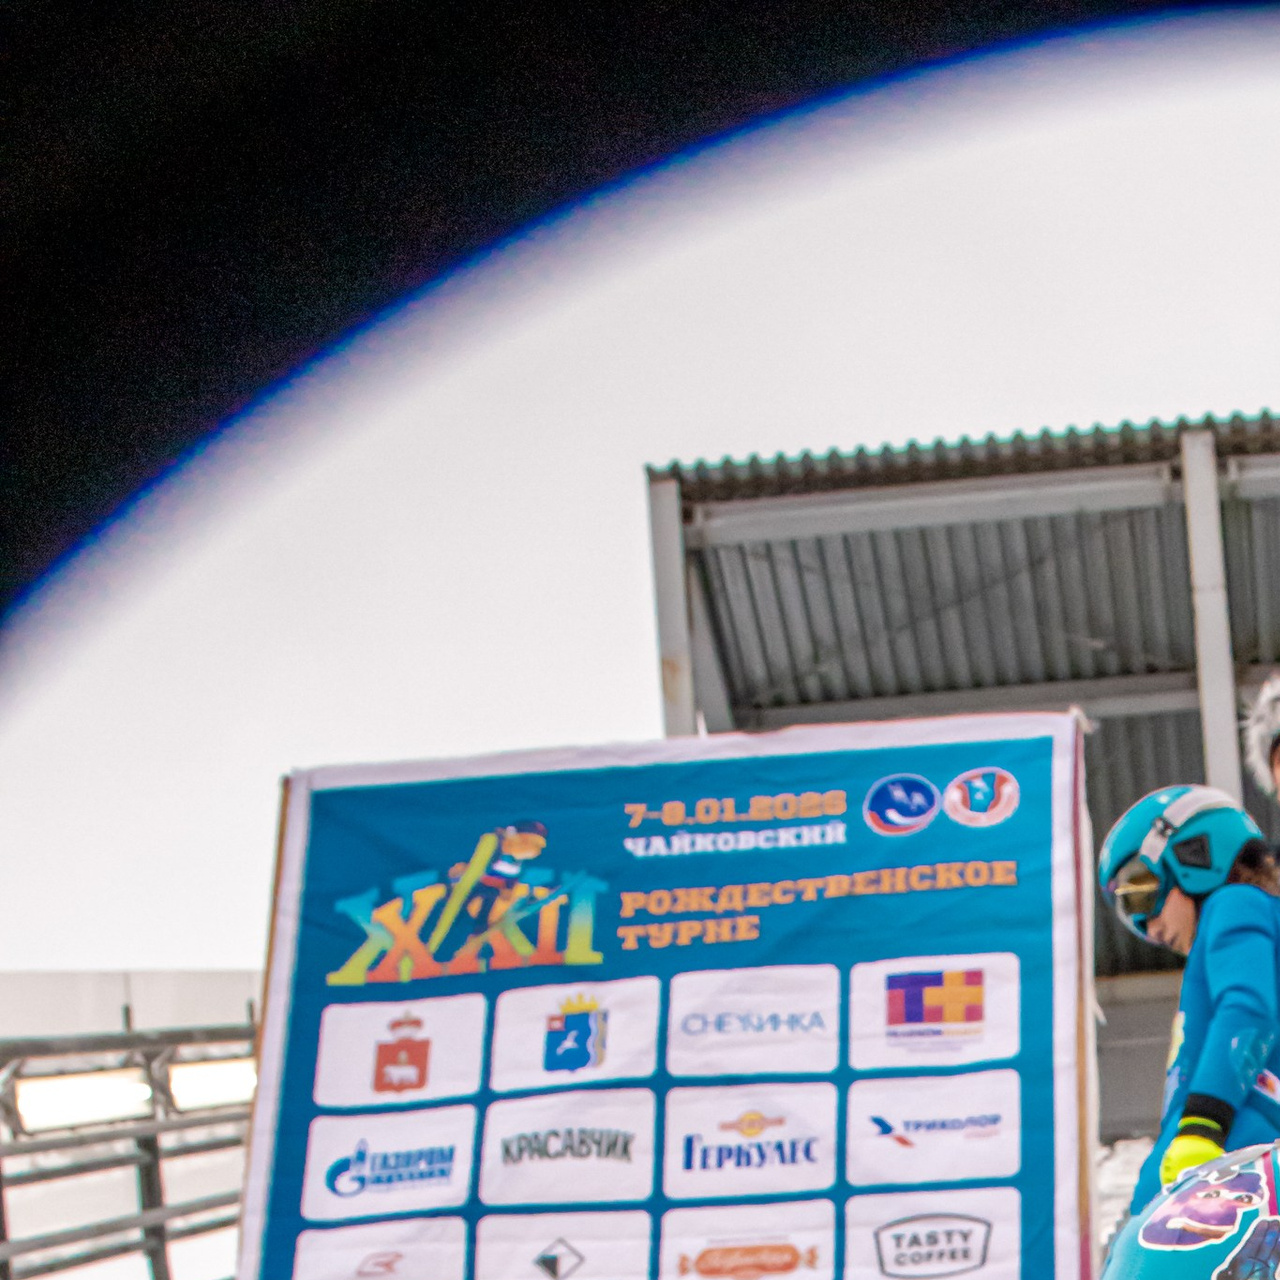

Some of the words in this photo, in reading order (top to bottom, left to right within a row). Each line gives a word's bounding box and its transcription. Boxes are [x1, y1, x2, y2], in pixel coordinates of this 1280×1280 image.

[623, 820, 848, 857] ЧАЙКОВСКИЙ
[619, 860, 1019, 918] РОЖДЕСТВЕНСКОЕ
[617, 915, 761, 950] ТУРНЕ
[501, 1127, 637, 1165] КРАСАВЧИК
[891, 1228, 974, 1249] TASTY
[893, 1247, 972, 1267] COFFEE
